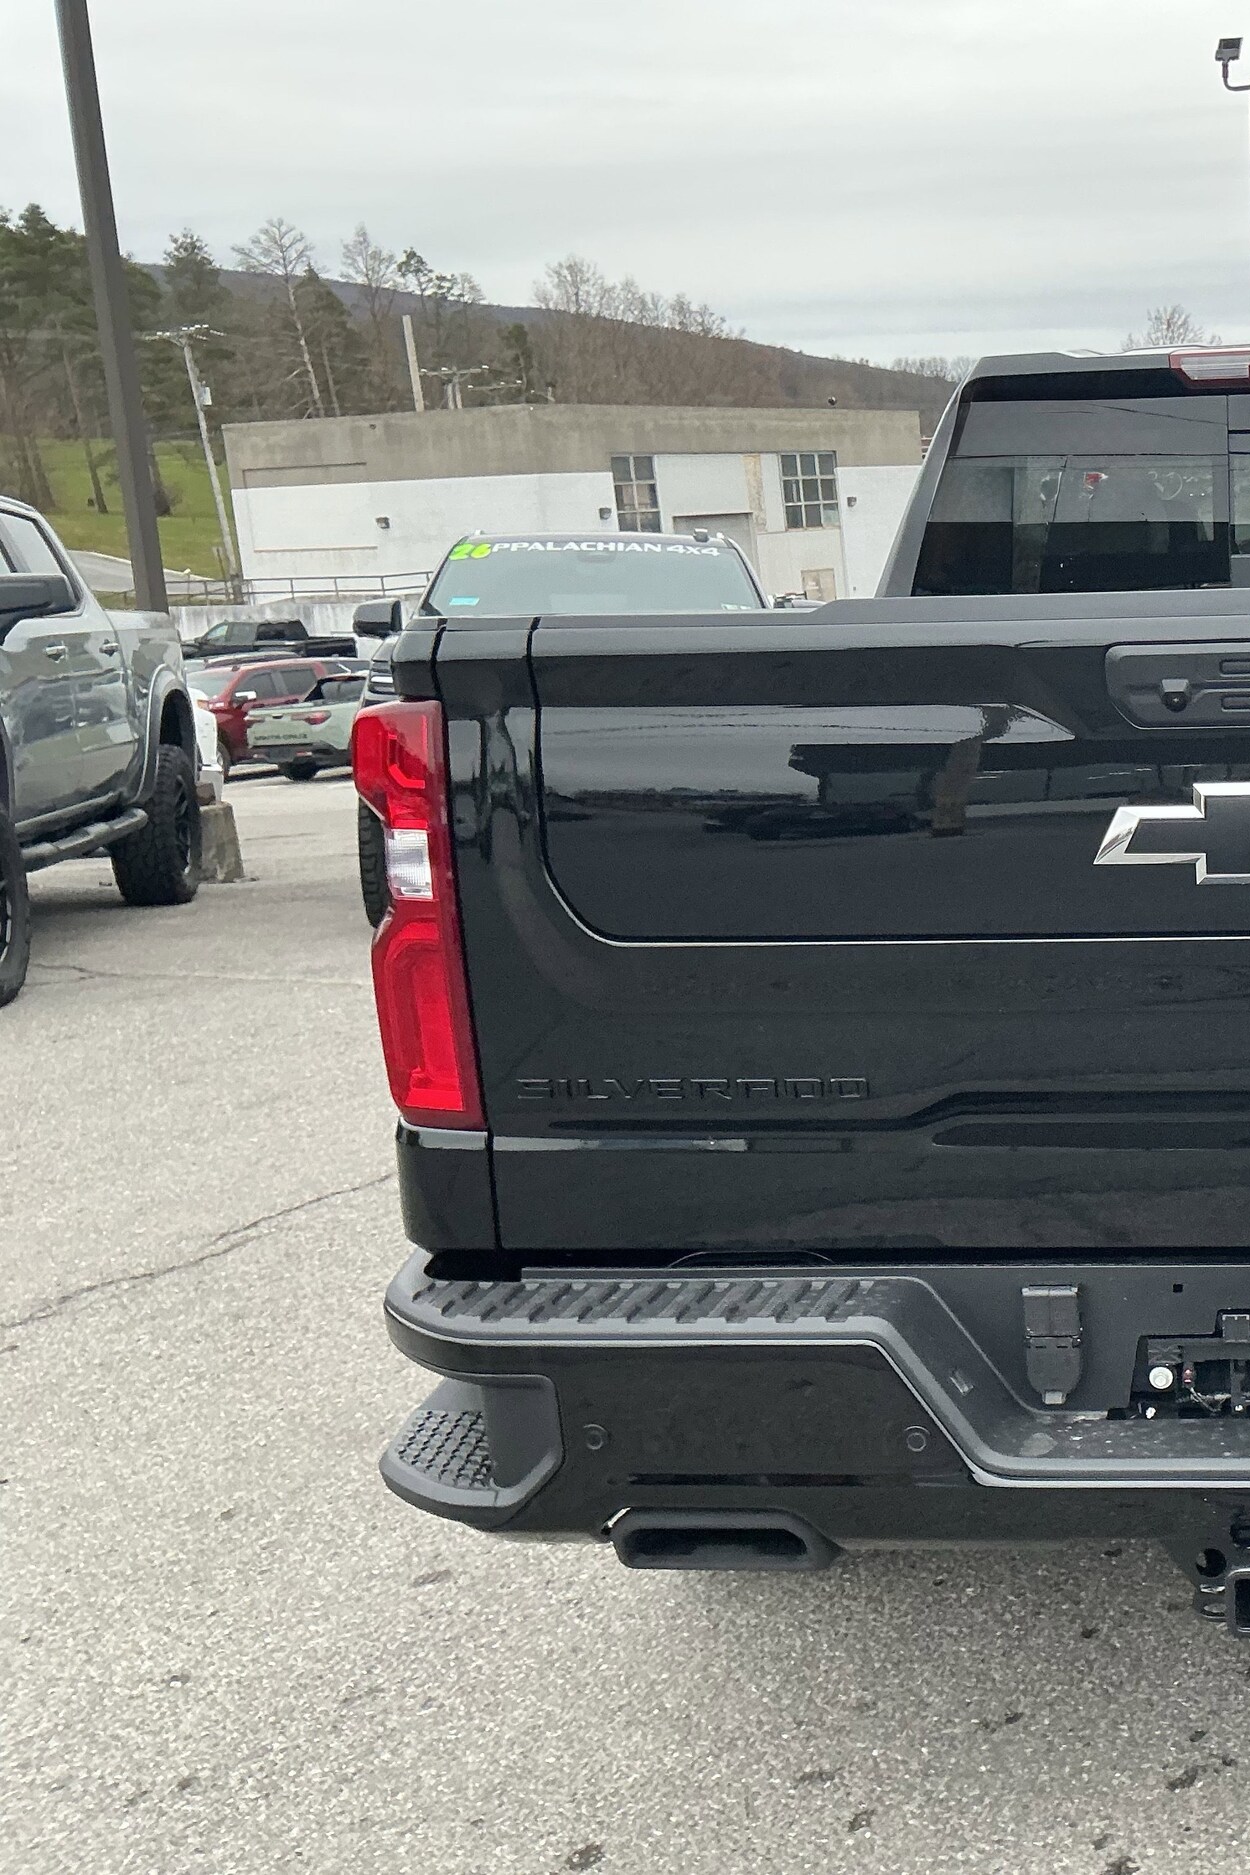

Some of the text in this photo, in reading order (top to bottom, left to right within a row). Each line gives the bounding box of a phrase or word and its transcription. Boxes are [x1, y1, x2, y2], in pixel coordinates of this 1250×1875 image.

[448, 543, 492, 561] 26
[491, 541, 662, 553] PPALACHIAN
[516, 1076, 871, 1100] SILVERADO
